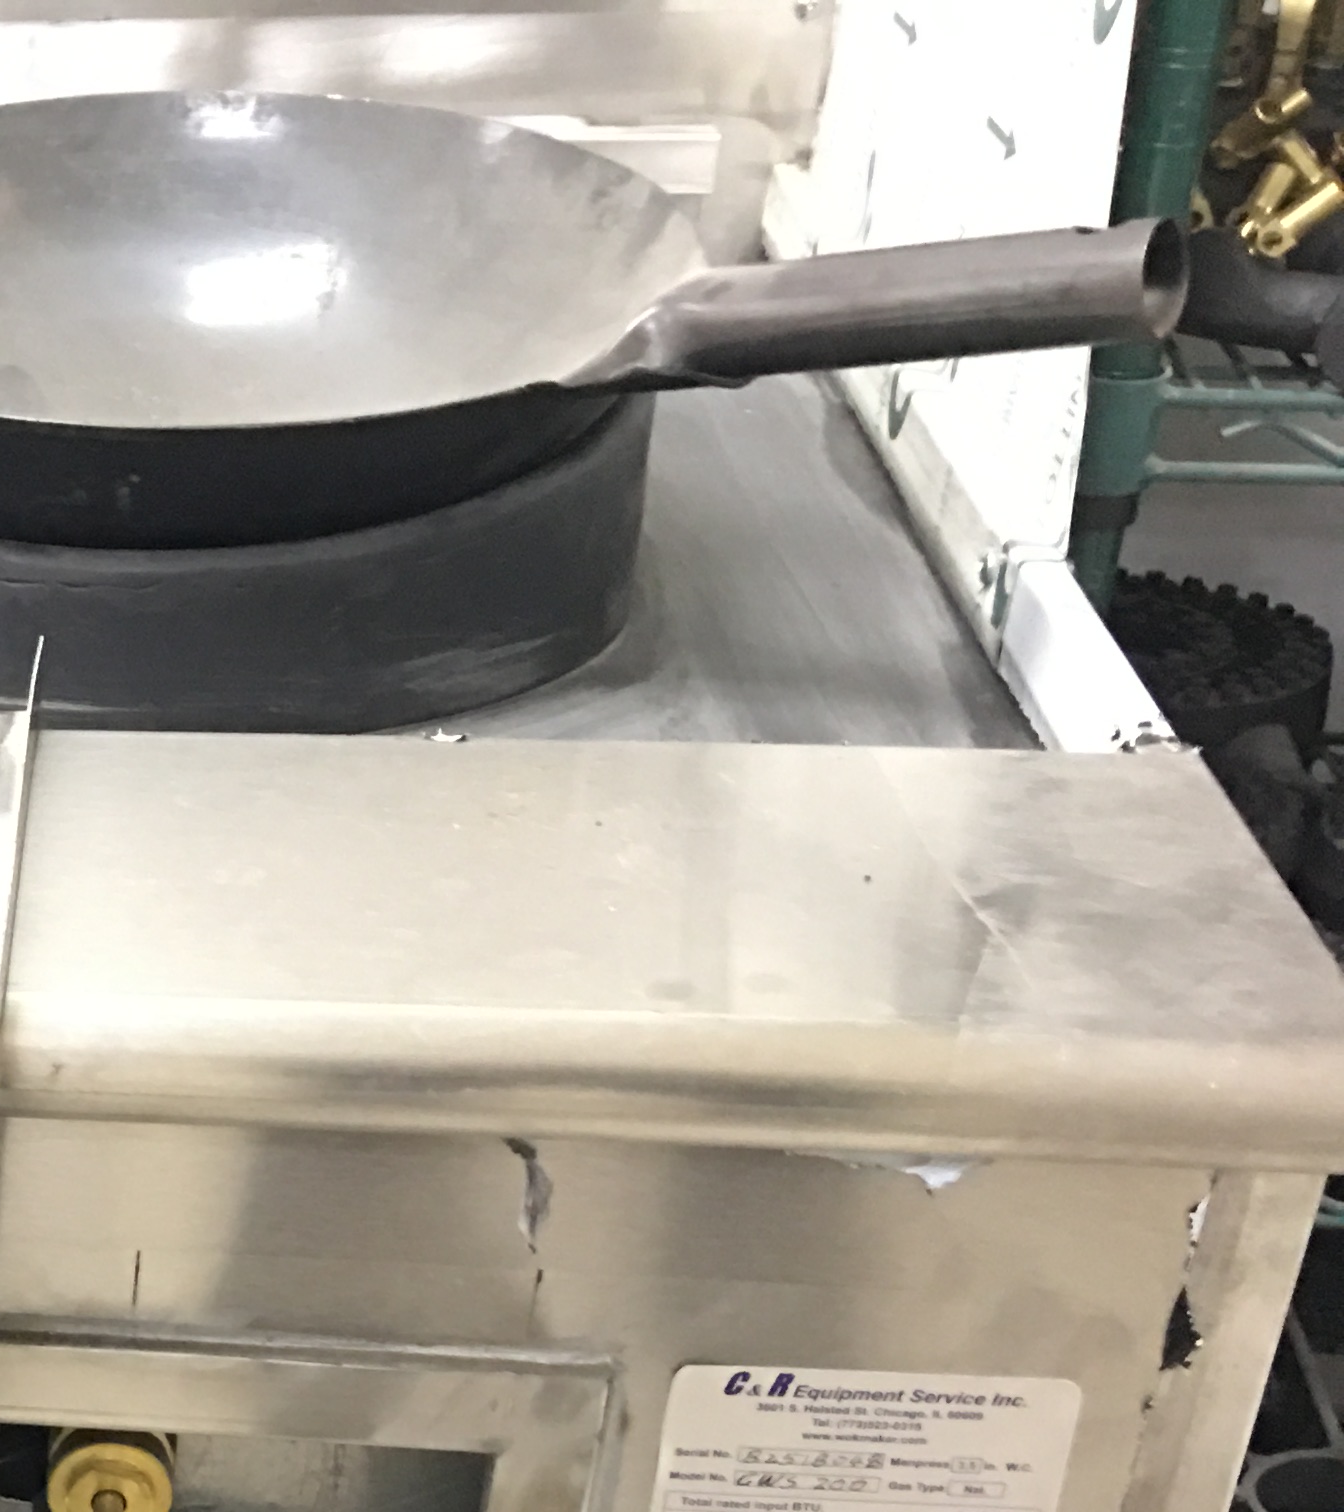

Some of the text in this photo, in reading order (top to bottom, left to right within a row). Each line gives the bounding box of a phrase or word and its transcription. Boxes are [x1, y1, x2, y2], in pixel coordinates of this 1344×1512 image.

[723, 1371, 751, 1395] C
[746, 1384, 761, 1396] &
[767, 1373, 795, 1397] R
[793, 1384, 905, 1403] Equipment
[910, 1389, 986, 1406] Service
[803, 1404, 850, 1415] Halsted
[675, 1447, 710, 1458] Serial
[669, 1471, 706, 1481] Model
[888, 1481, 912, 1491] Gas
[681, 1496, 712, 1507] Total
[716, 1500, 750, 1509] rated
[754, 1501, 788, 1511] input
